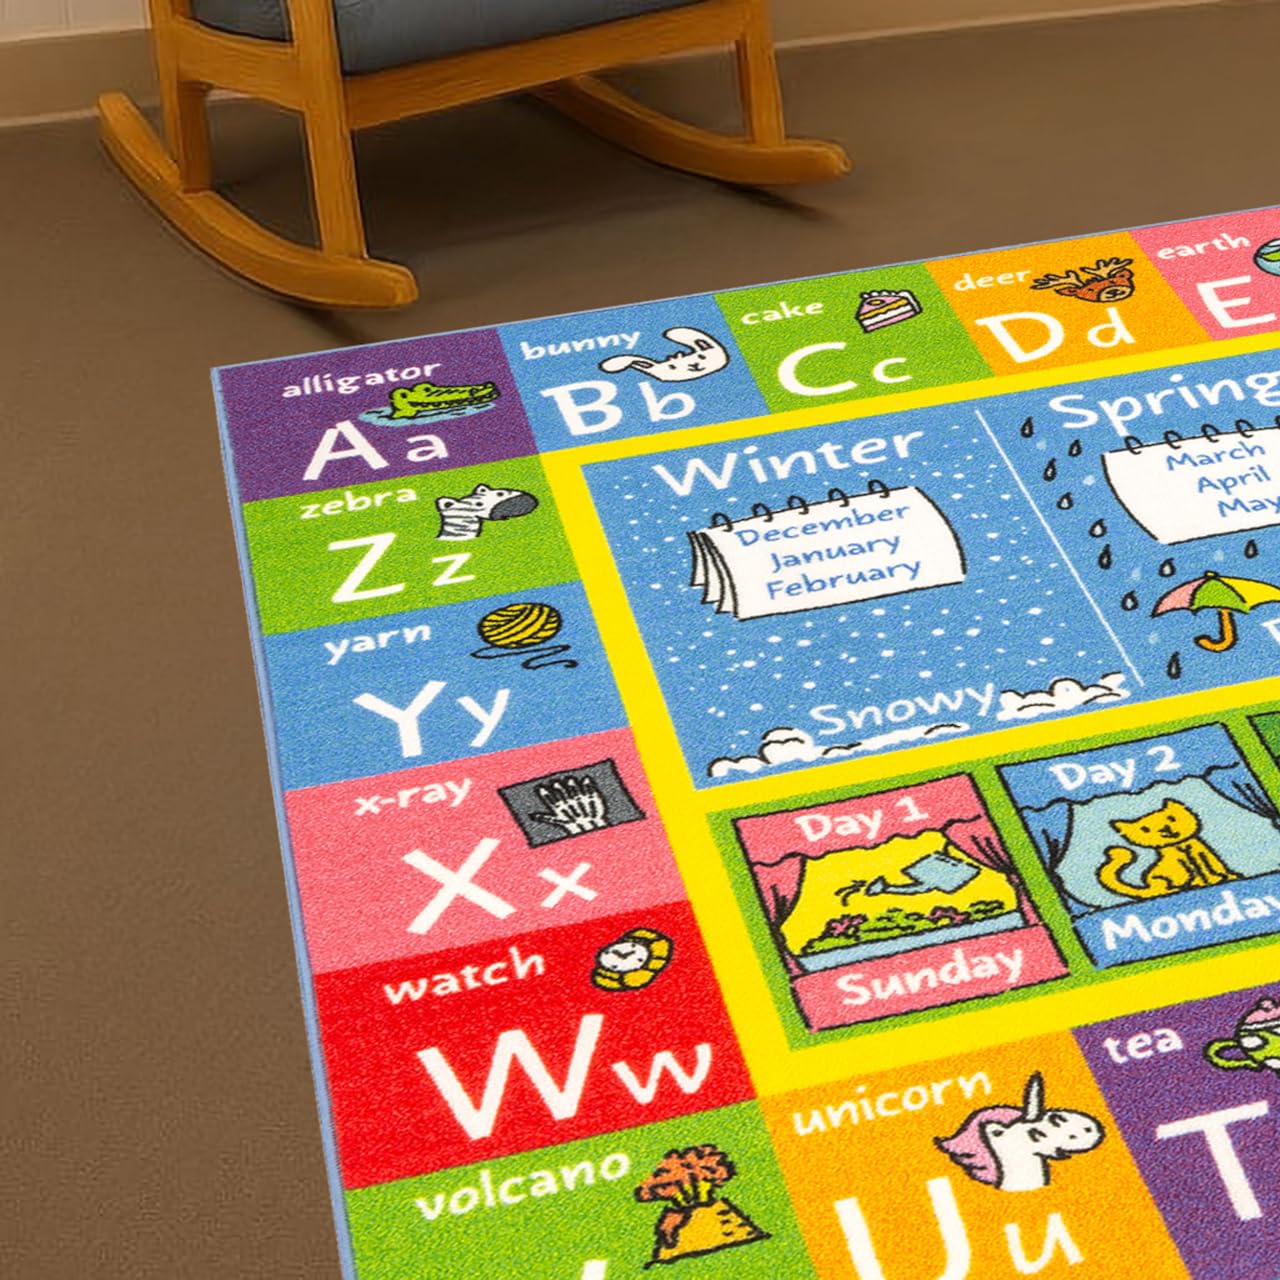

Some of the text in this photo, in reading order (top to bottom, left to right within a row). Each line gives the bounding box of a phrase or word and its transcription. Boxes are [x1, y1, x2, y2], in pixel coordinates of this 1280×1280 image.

[1156, 232, 1251, 261] earth
[953, 268, 1030, 292] deer
[740, 302, 823, 325] cake
[521, 331, 640, 361] bunny
[282, 361, 441, 399] alligator
[653, 426, 924, 497] Winter
[1165, 441, 1265, 471] March
[1197, 465, 1271, 495] April
[299, 486, 418, 520] zebra
[735, 503, 910, 548] December
[771, 534, 899, 573] January
[766, 558, 921, 603] February
[323, 623, 431, 664] yarn
[809, 680, 997, 736] Snowy
[1049, 745, 1181, 791] Day 2
[354, 778, 472, 817] x-ray
[794, 795, 929, 843] Day 1
[383, 947, 545, 1005] watch
[834, 945, 1023, 1005] Sunday
[1104, 1026, 1182, 1064] tea
[792, 1069, 991, 1137] unicorn
[412, 1151, 629, 1221] volcano
